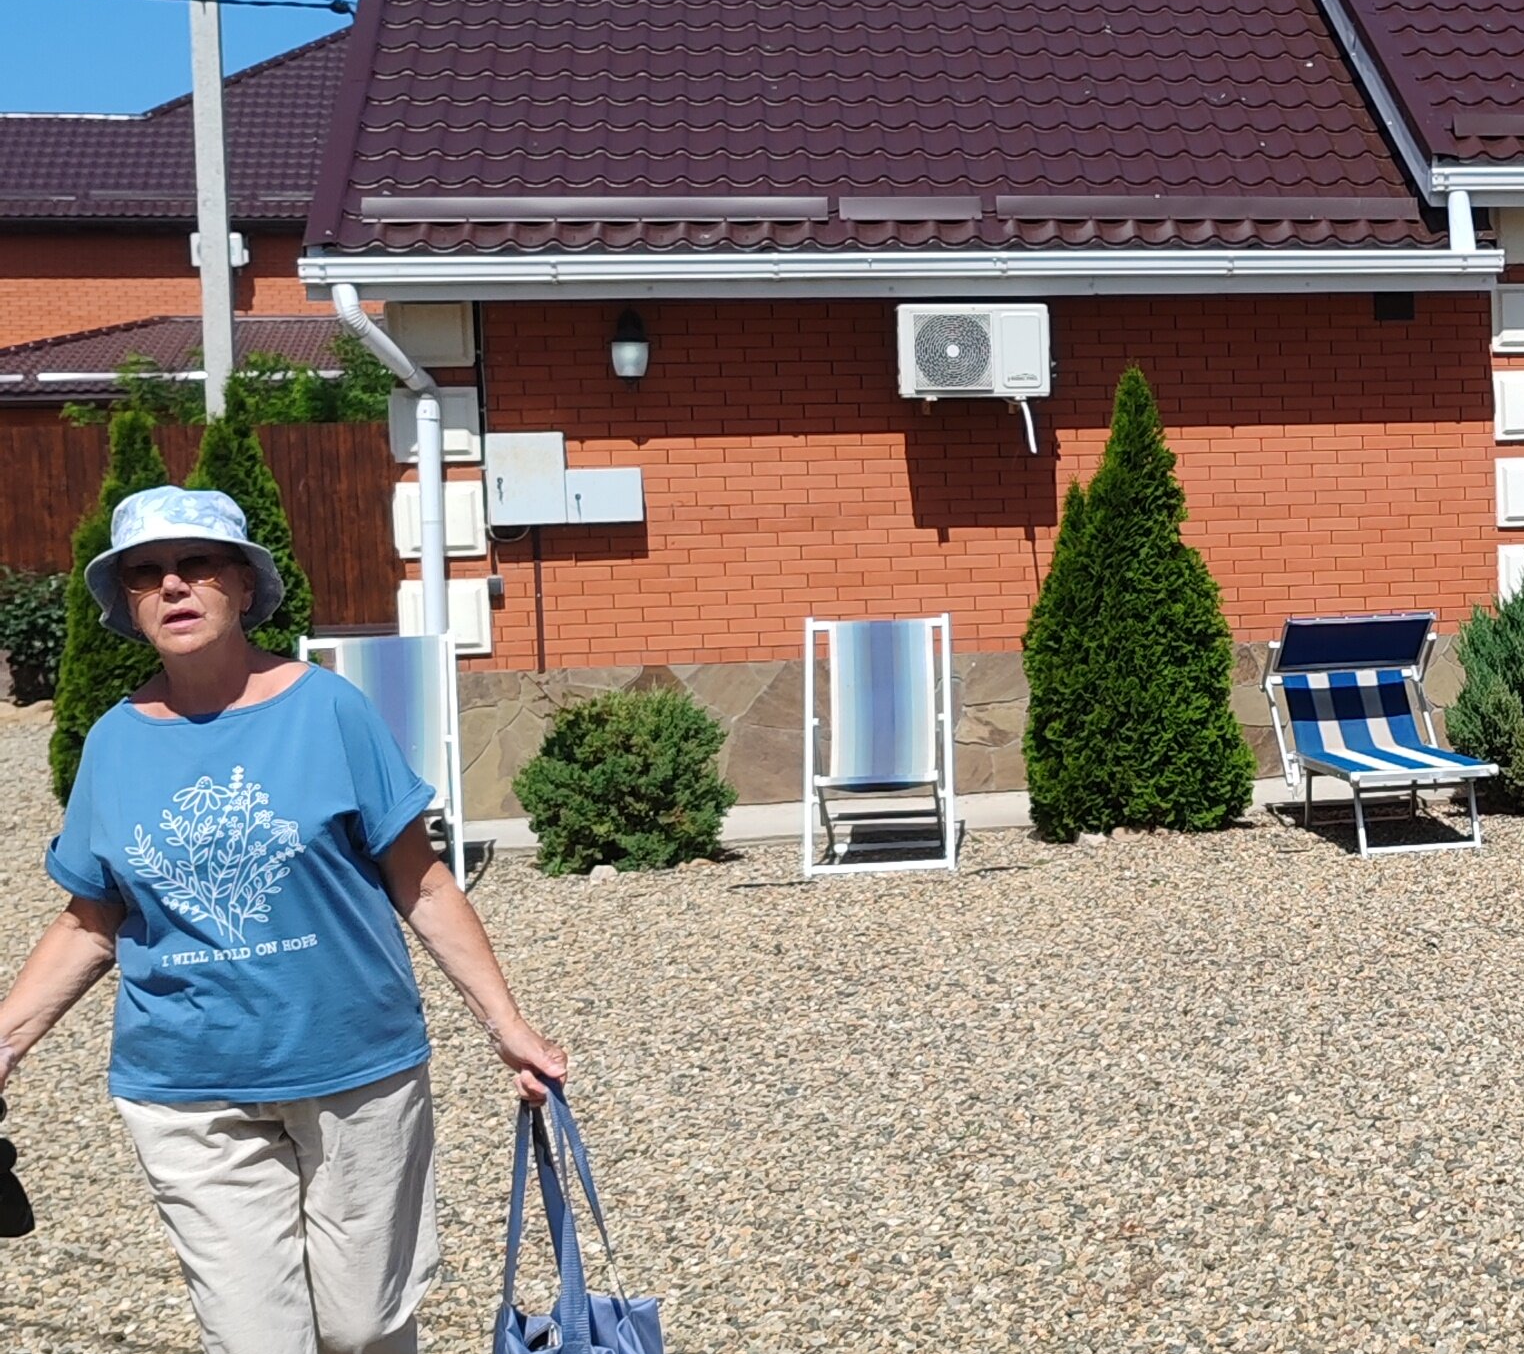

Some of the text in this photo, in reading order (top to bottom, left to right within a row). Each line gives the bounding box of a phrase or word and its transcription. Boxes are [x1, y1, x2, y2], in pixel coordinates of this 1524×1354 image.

[162, 955, 169, 967] I
[172, 950, 209, 966] WILL
[255, 941, 278, 956] ON
[282, 934, 318, 951] HOPE
